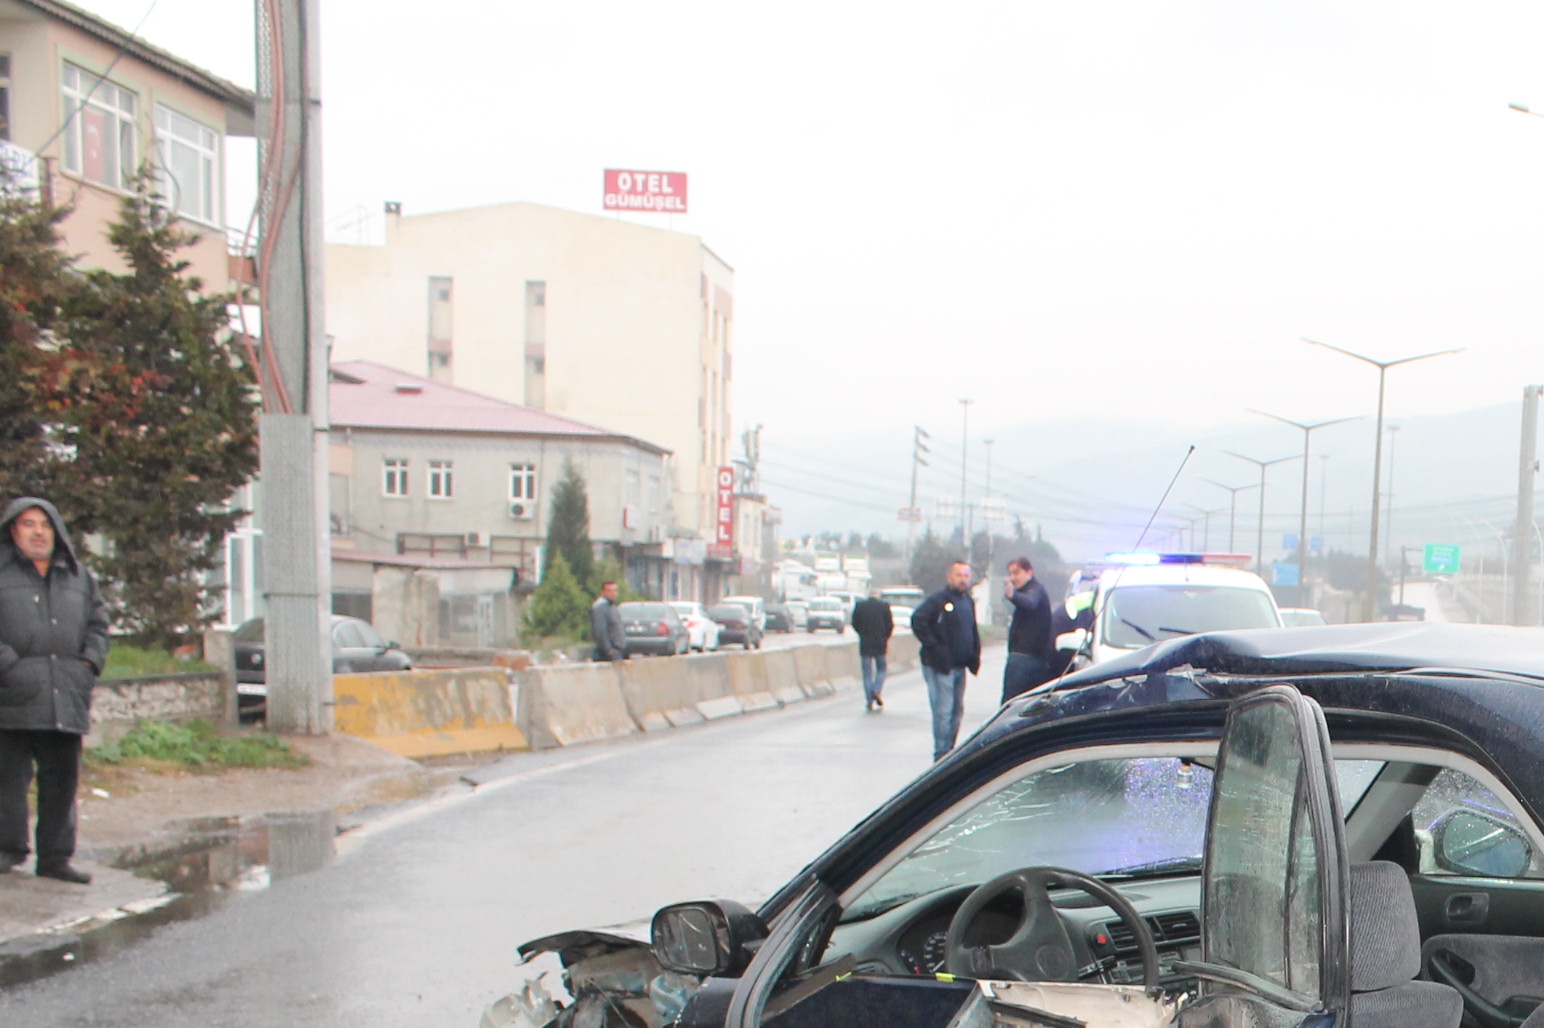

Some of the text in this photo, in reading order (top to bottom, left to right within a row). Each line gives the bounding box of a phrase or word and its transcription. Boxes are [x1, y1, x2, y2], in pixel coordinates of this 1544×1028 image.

[617, 172, 674, 194] OTEL
[605, 191, 685, 211] GÜMÜŞEL
[719, 471, 732, 541] OTEL
